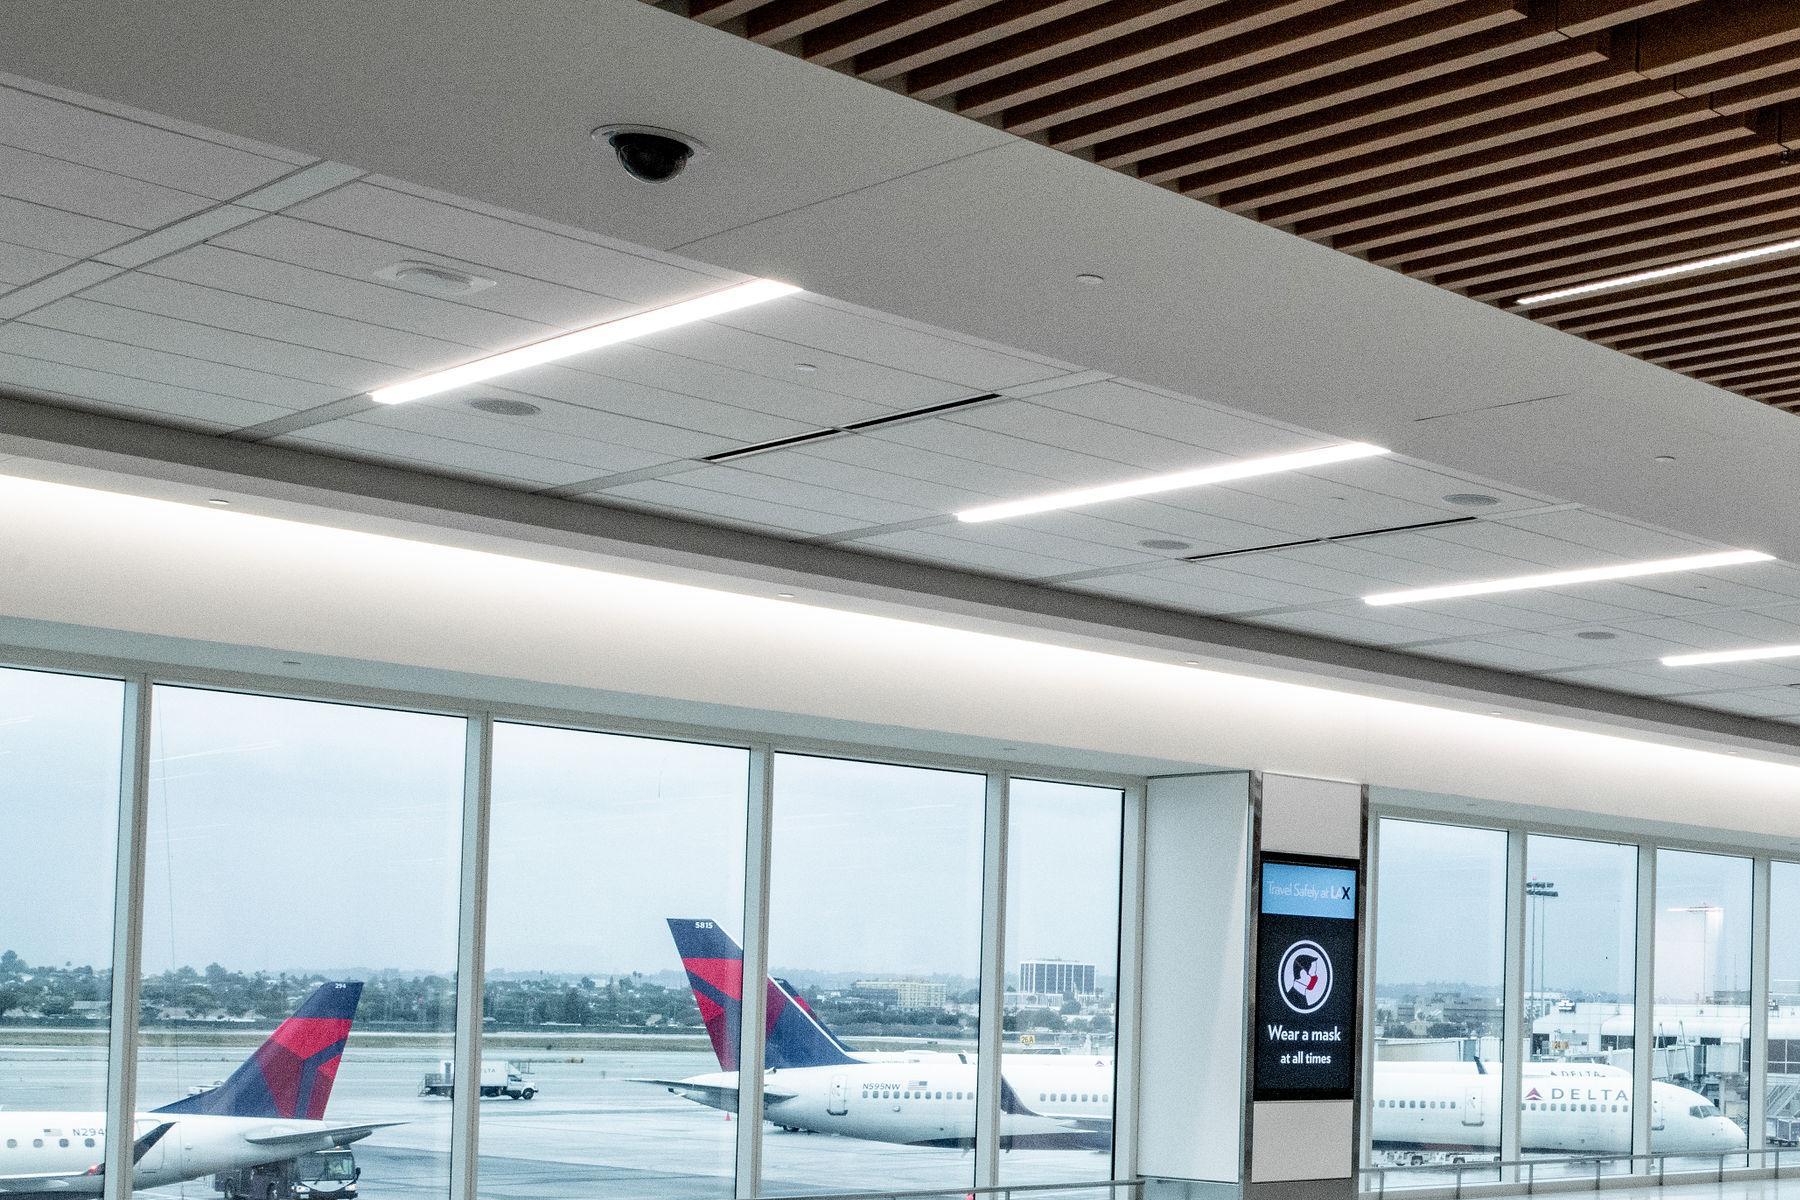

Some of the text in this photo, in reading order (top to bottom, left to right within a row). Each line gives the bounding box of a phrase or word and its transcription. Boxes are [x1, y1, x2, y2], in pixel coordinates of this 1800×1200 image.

[1268, 1024, 1341, 1042] Wear a mask
[1280, 1051, 1331, 1064] at all times
[1551, 1088, 1628, 1101] DELTA
